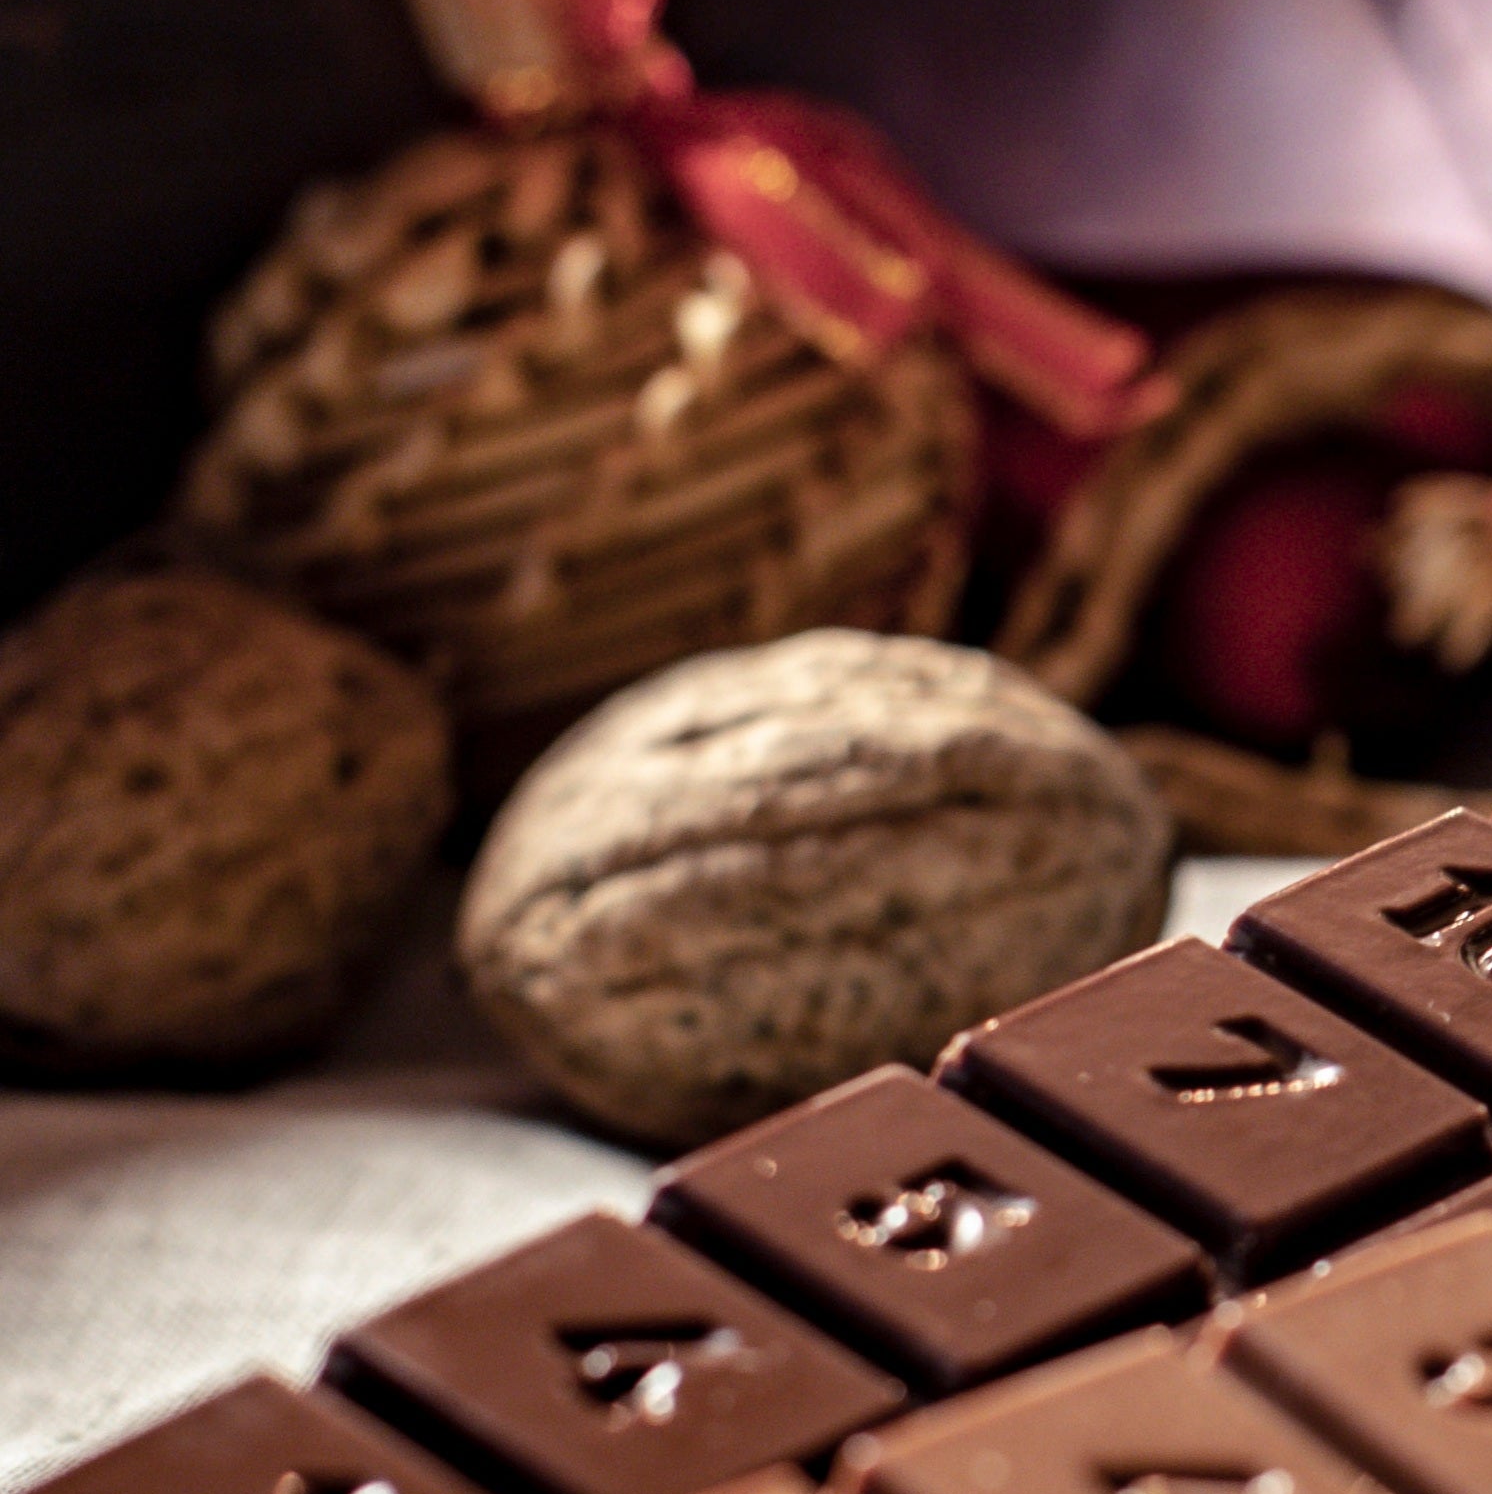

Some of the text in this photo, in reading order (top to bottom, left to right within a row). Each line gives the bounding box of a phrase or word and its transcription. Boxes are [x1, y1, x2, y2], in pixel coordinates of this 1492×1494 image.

[1150, 1015, 1343, 1104] 7
[836, 1157, 1038, 1272] 5
[555, 1312, 742, 1427] 4
